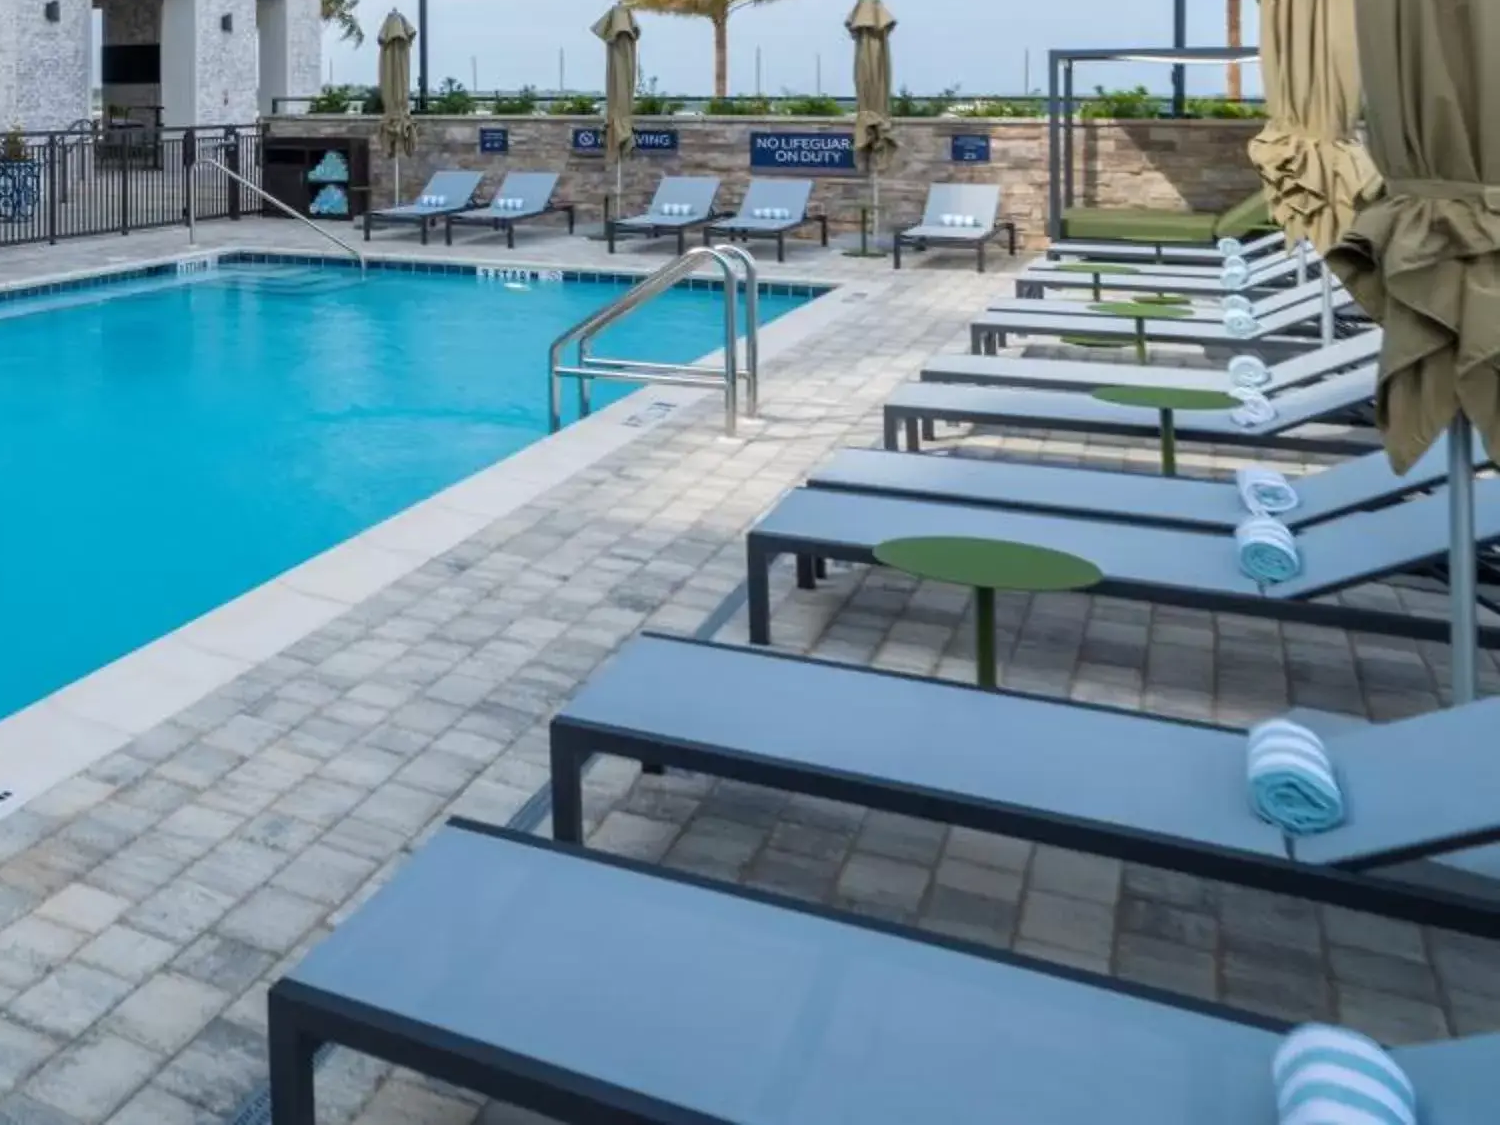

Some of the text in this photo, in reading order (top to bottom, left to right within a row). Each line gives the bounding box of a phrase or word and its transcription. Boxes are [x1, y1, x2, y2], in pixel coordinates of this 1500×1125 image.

[756, 138, 852, 150] NO LIFEGUAR
[775, 150, 841, 163] ON DUTY
